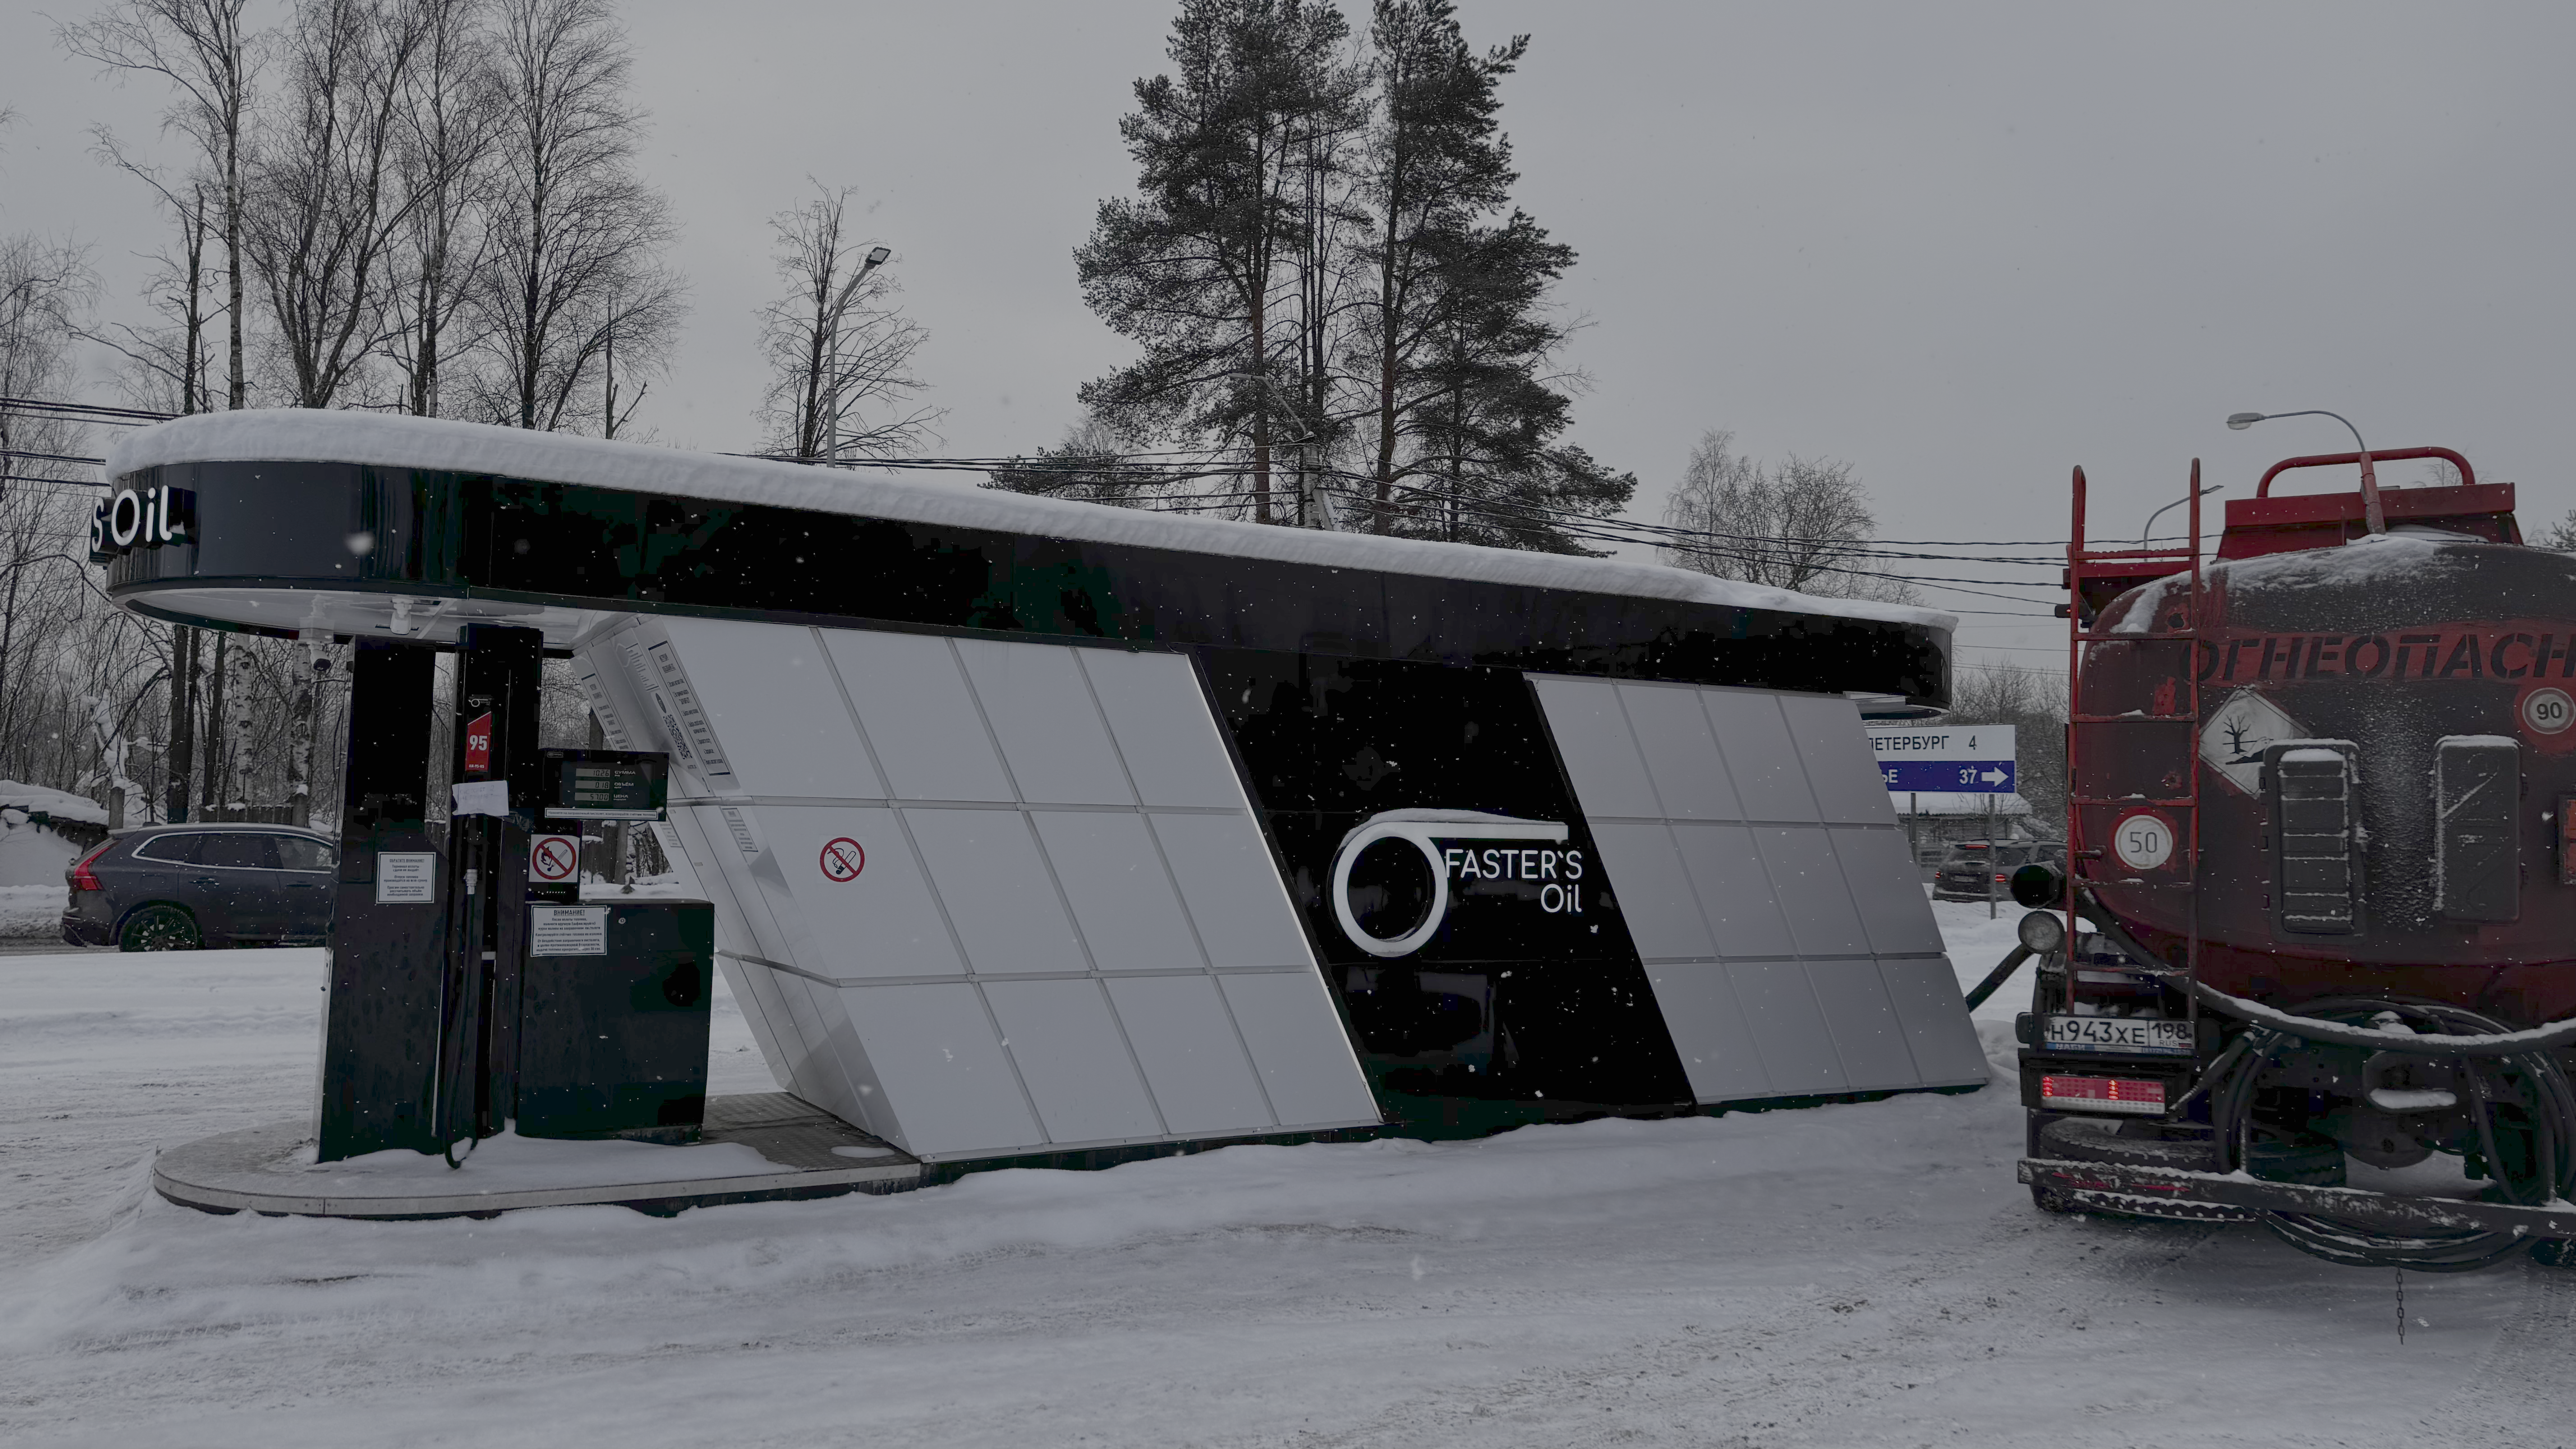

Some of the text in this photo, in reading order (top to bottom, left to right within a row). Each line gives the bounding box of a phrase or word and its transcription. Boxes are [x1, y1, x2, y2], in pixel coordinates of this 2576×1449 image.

[111, 485, 172, 546] Oil
[2537, 702, 2562, 720] 90
[469, 735, 488, 750] 95
[1969, 736, 1977, 750] 4
[1960, 769, 1977, 784] 37
[2130, 832, 2157, 853] 50
[1541, 883, 1582, 913] Oil
[2151, 1022, 2187, 1040] 198
